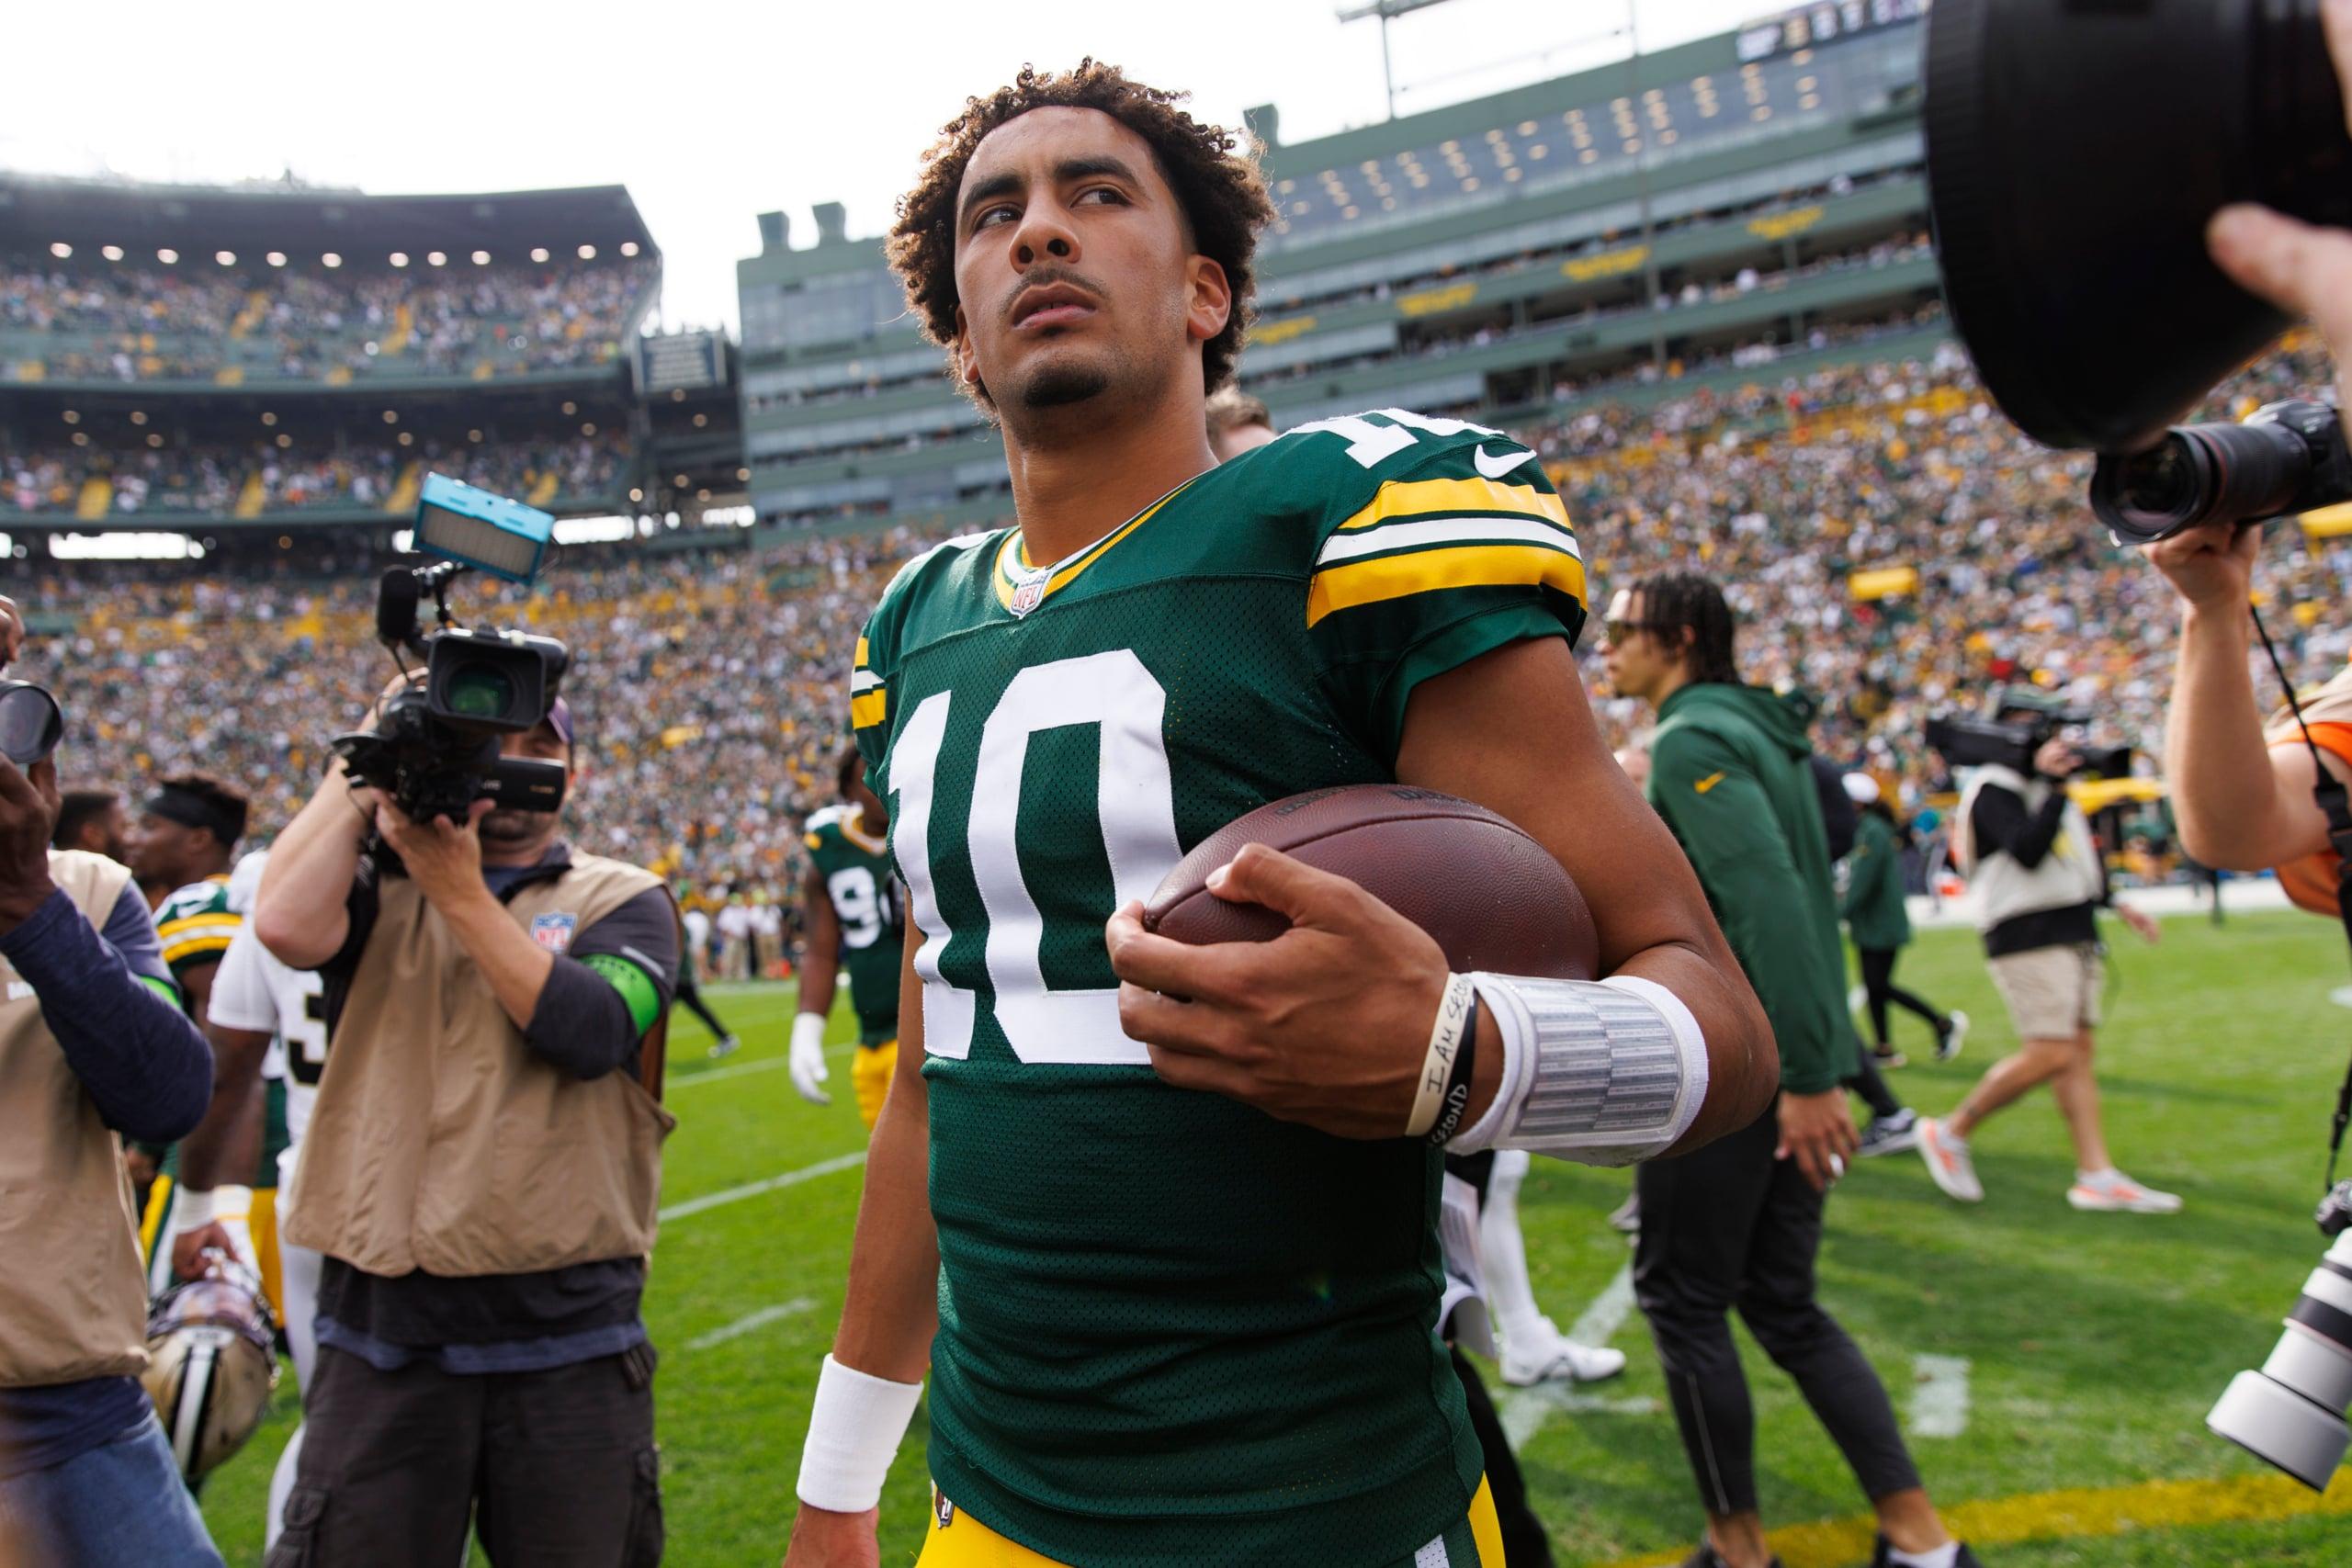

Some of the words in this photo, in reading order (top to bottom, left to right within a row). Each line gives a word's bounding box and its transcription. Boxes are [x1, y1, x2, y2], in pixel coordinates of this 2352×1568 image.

[1014, 585, 1037, 608] NFL
[888, 649, 1183, 1064] 10
[1434, 1027, 1455, 1064] AM
[1426, 1066, 1446, 1095] I
[1431, 1084, 1468, 1144] SECOND
